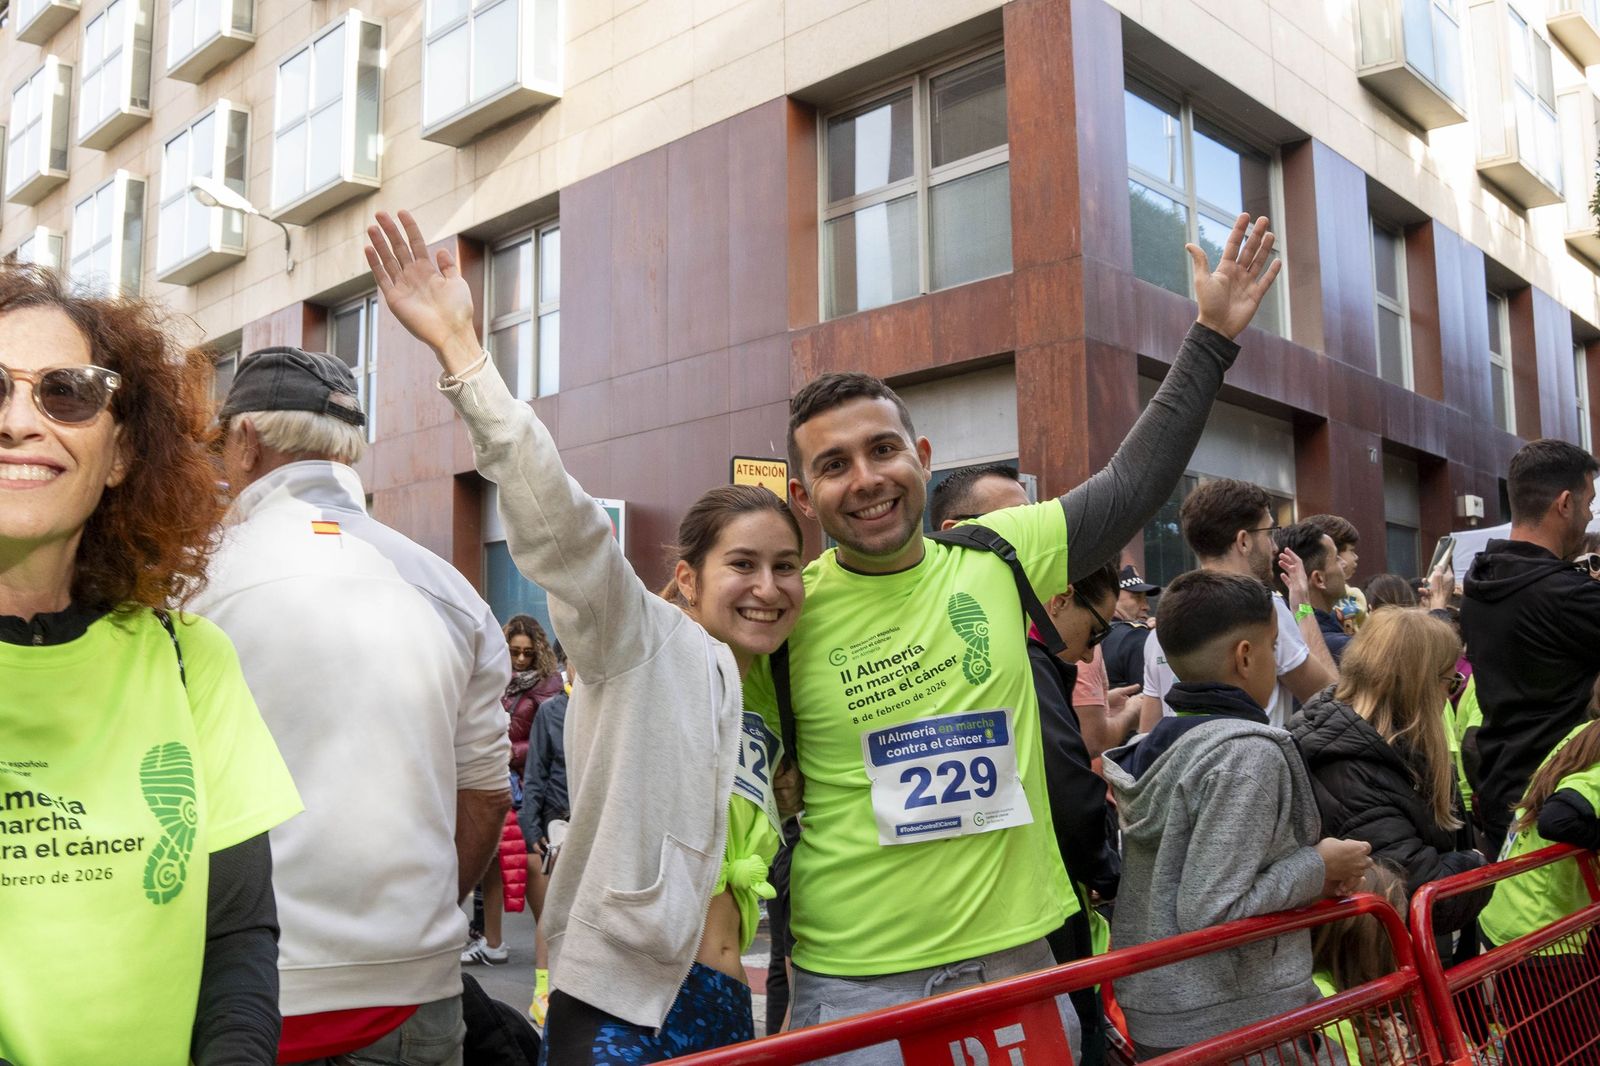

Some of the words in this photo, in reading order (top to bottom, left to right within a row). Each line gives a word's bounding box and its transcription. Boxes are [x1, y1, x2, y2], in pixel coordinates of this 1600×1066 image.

[736, 463, 786, 478] ATENCIÓN
[840, 669, 852, 685] II
[856, 644, 925, 679] Almería
[845, 684, 863, 697] en
[866, 660, 921, 690] marcha
[848, 687, 897, 711] contra
[899, 677, 914, 692] el
[914, 654, 958, 684] cáncer
[853, 717, 860, 725] 8
[861, 712, 874, 722] de
[876, 699, 911, 718] febrero
[912, 692, 924, 702] de
[926, 679, 947, 696] 2026
[886, 742, 928, 758] contra
[930, 738, 943, 749] el
[945, 734, 983, 748] cáncer
[887, 725, 937, 744] Almería
[938, 724, 954, 734] en
[956, 718, 995, 731] marcha
[900, 756, 998, 810] 229
[35, 837, 60, 858] el
[65, 835, 145, 857] cáncer
[51, 870, 70, 884] de
[74, 867, 114, 882] 2026
